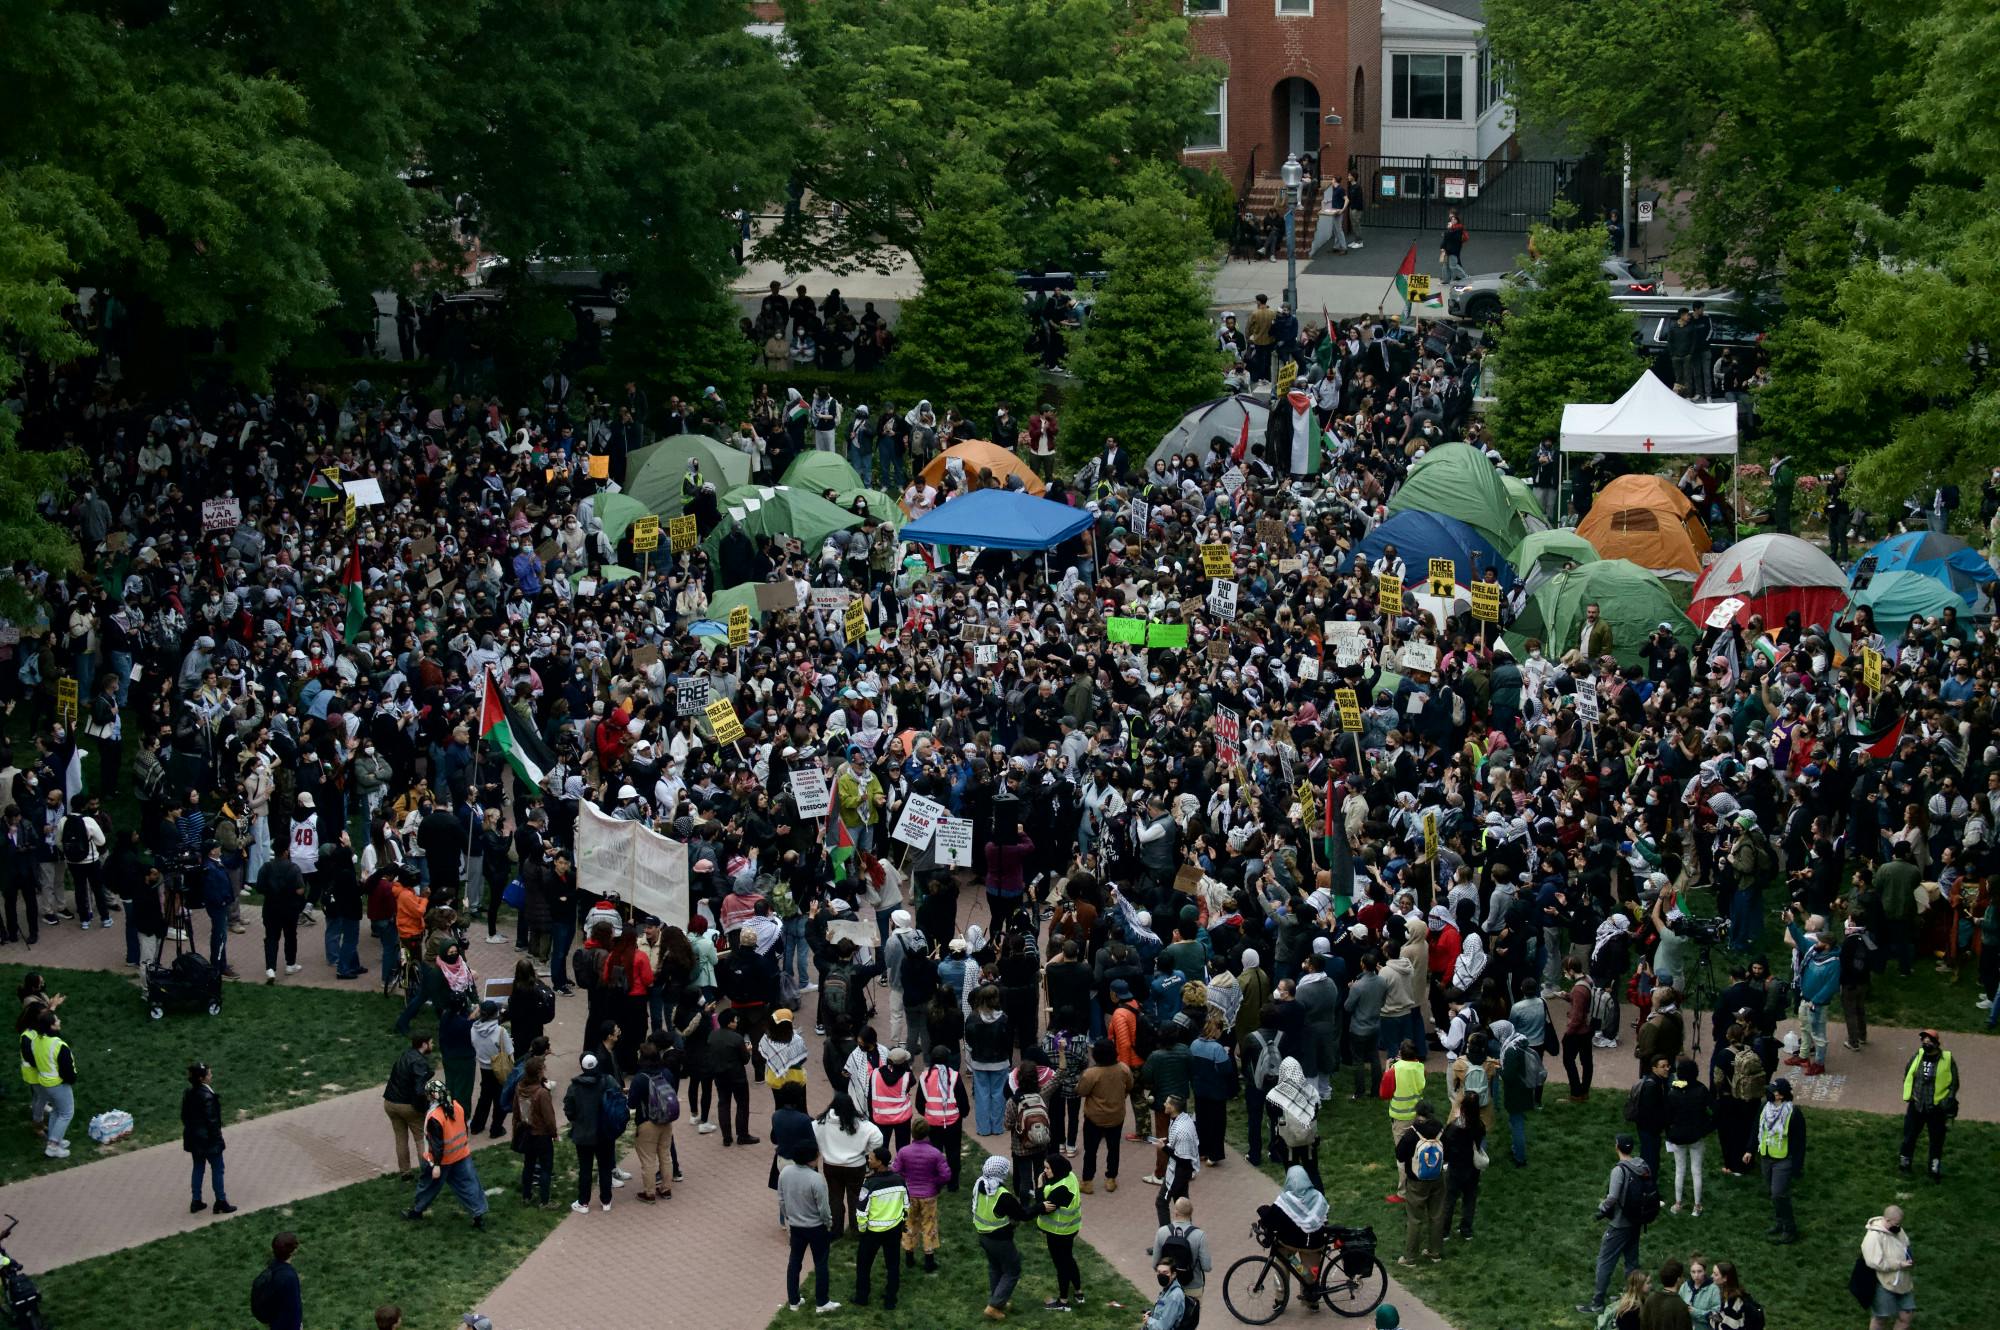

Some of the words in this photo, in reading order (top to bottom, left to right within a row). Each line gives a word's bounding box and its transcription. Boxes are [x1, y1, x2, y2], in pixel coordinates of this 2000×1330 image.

[1410, 275, 1429, 284] FREE
[205, 509, 232, 519] WAR
[203, 517, 237, 529] MACHINE
[672, 527, 685, 536] END
[685, 525, 697, 534] THE
[673, 535, 696, 550] NOW!
[1431, 560, 1452, 572] FREE
[1218, 580, 1232, 591] END
[1472, 583, 1485, 592] FREE
[1486, 586, 1497, 595] ALL
[1218, 589, 1230, 600] ALL
[1223, 599, 1234, 610] AID
[678, 682, 708, 703] FREE
[708, 705, 721, 717] FREE
[720, 701, 731, 712] ALL
[716, 718, 739, 736] POLITICAL
[1216, 714, 1239, 741] BLOOD
[719, 727, 743, 742] PRISONERS
[800, 802, 828, 812] FREEDOM
[911, 798, 925, 807] COP
[925, 804, 939, 813] CITY
[909, 813, 930, 828] WAR
[295, 829, 313, 845] 48
